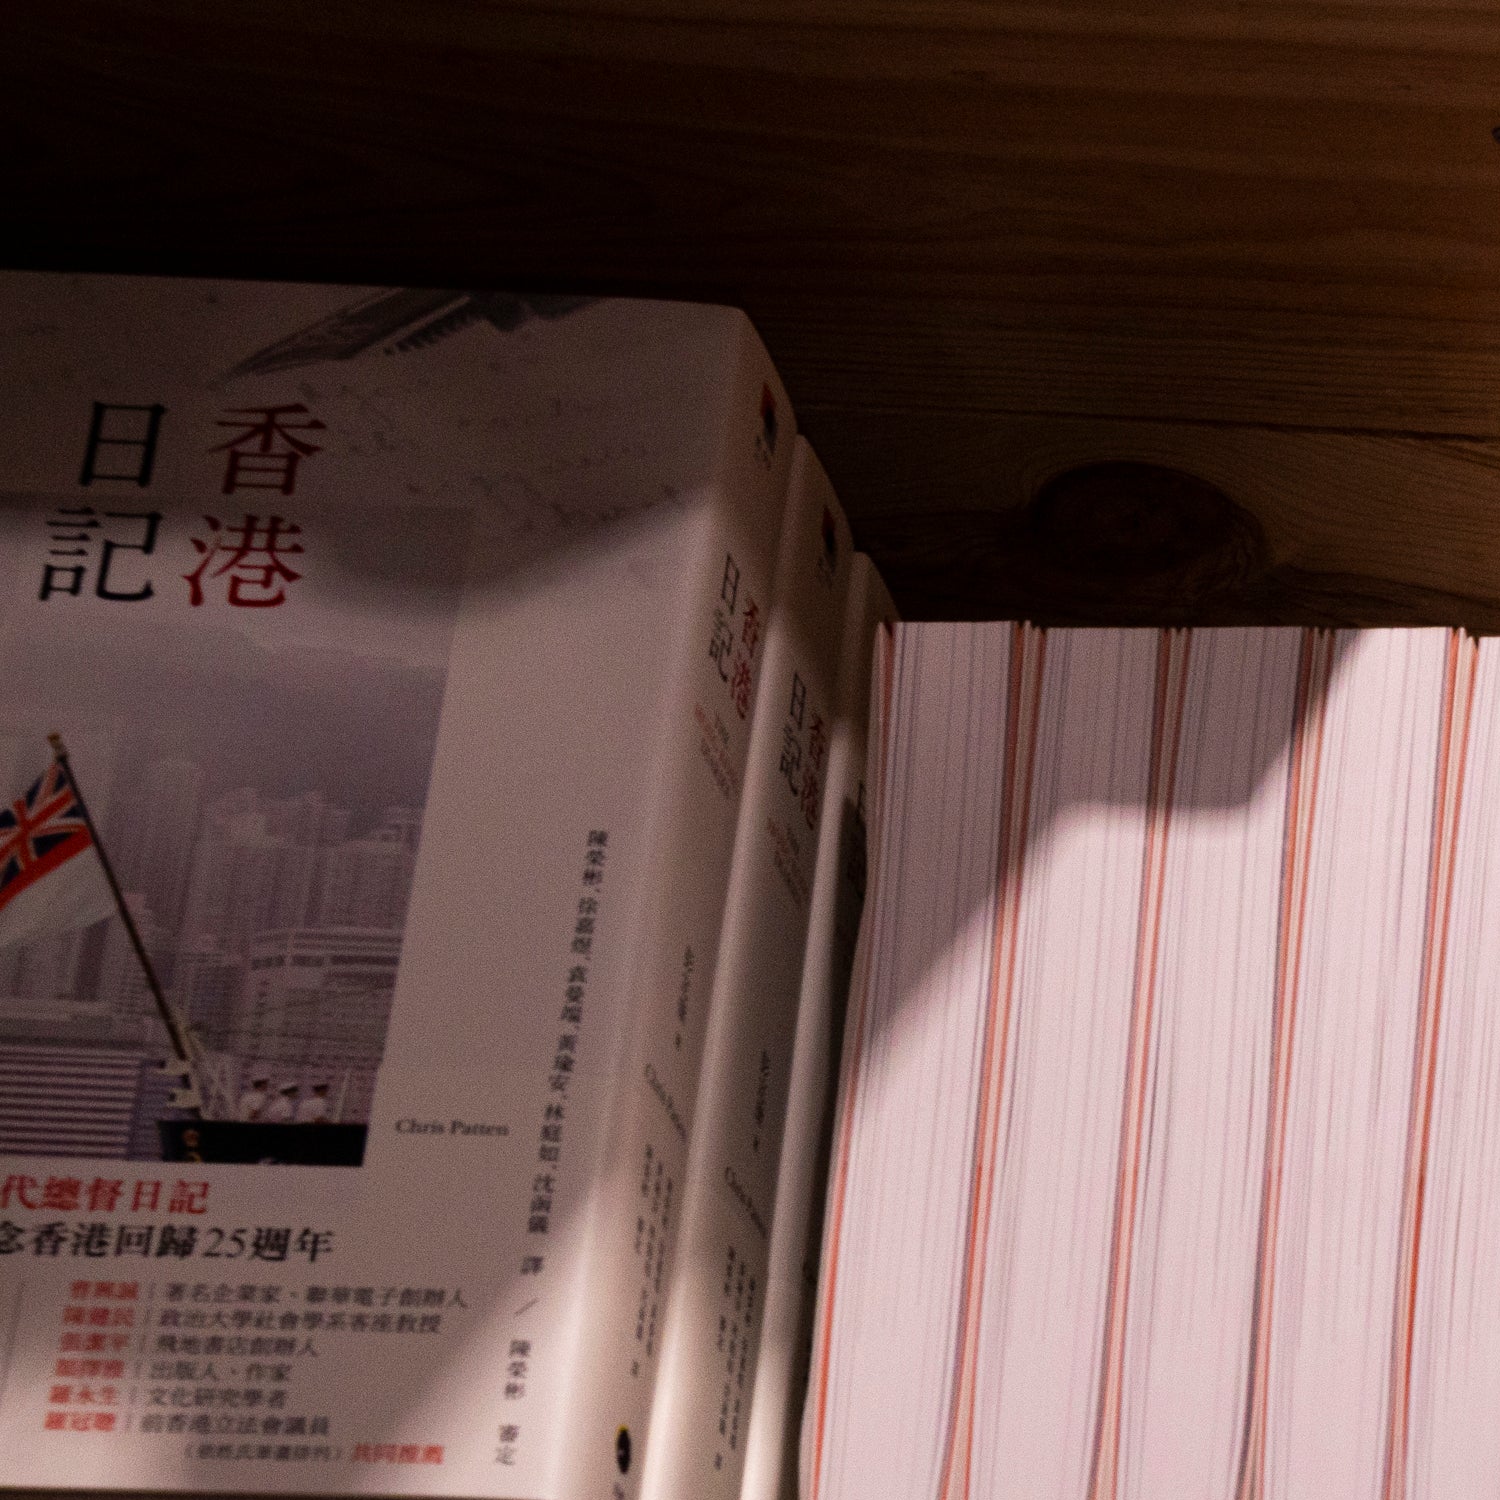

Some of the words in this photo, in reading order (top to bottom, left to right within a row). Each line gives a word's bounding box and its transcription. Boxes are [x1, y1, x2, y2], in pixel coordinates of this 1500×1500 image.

[37, 399, 170, 602] 日記
[182, 401, 328, 609] 香港
[395, 1119, 446, 1135] Chris
[449, 1120, 510, 1138] Patten
[1, 1173, 211, 1215] 代總督日記
[0, 1221, 335, 1264] 念香港回歸25週年
